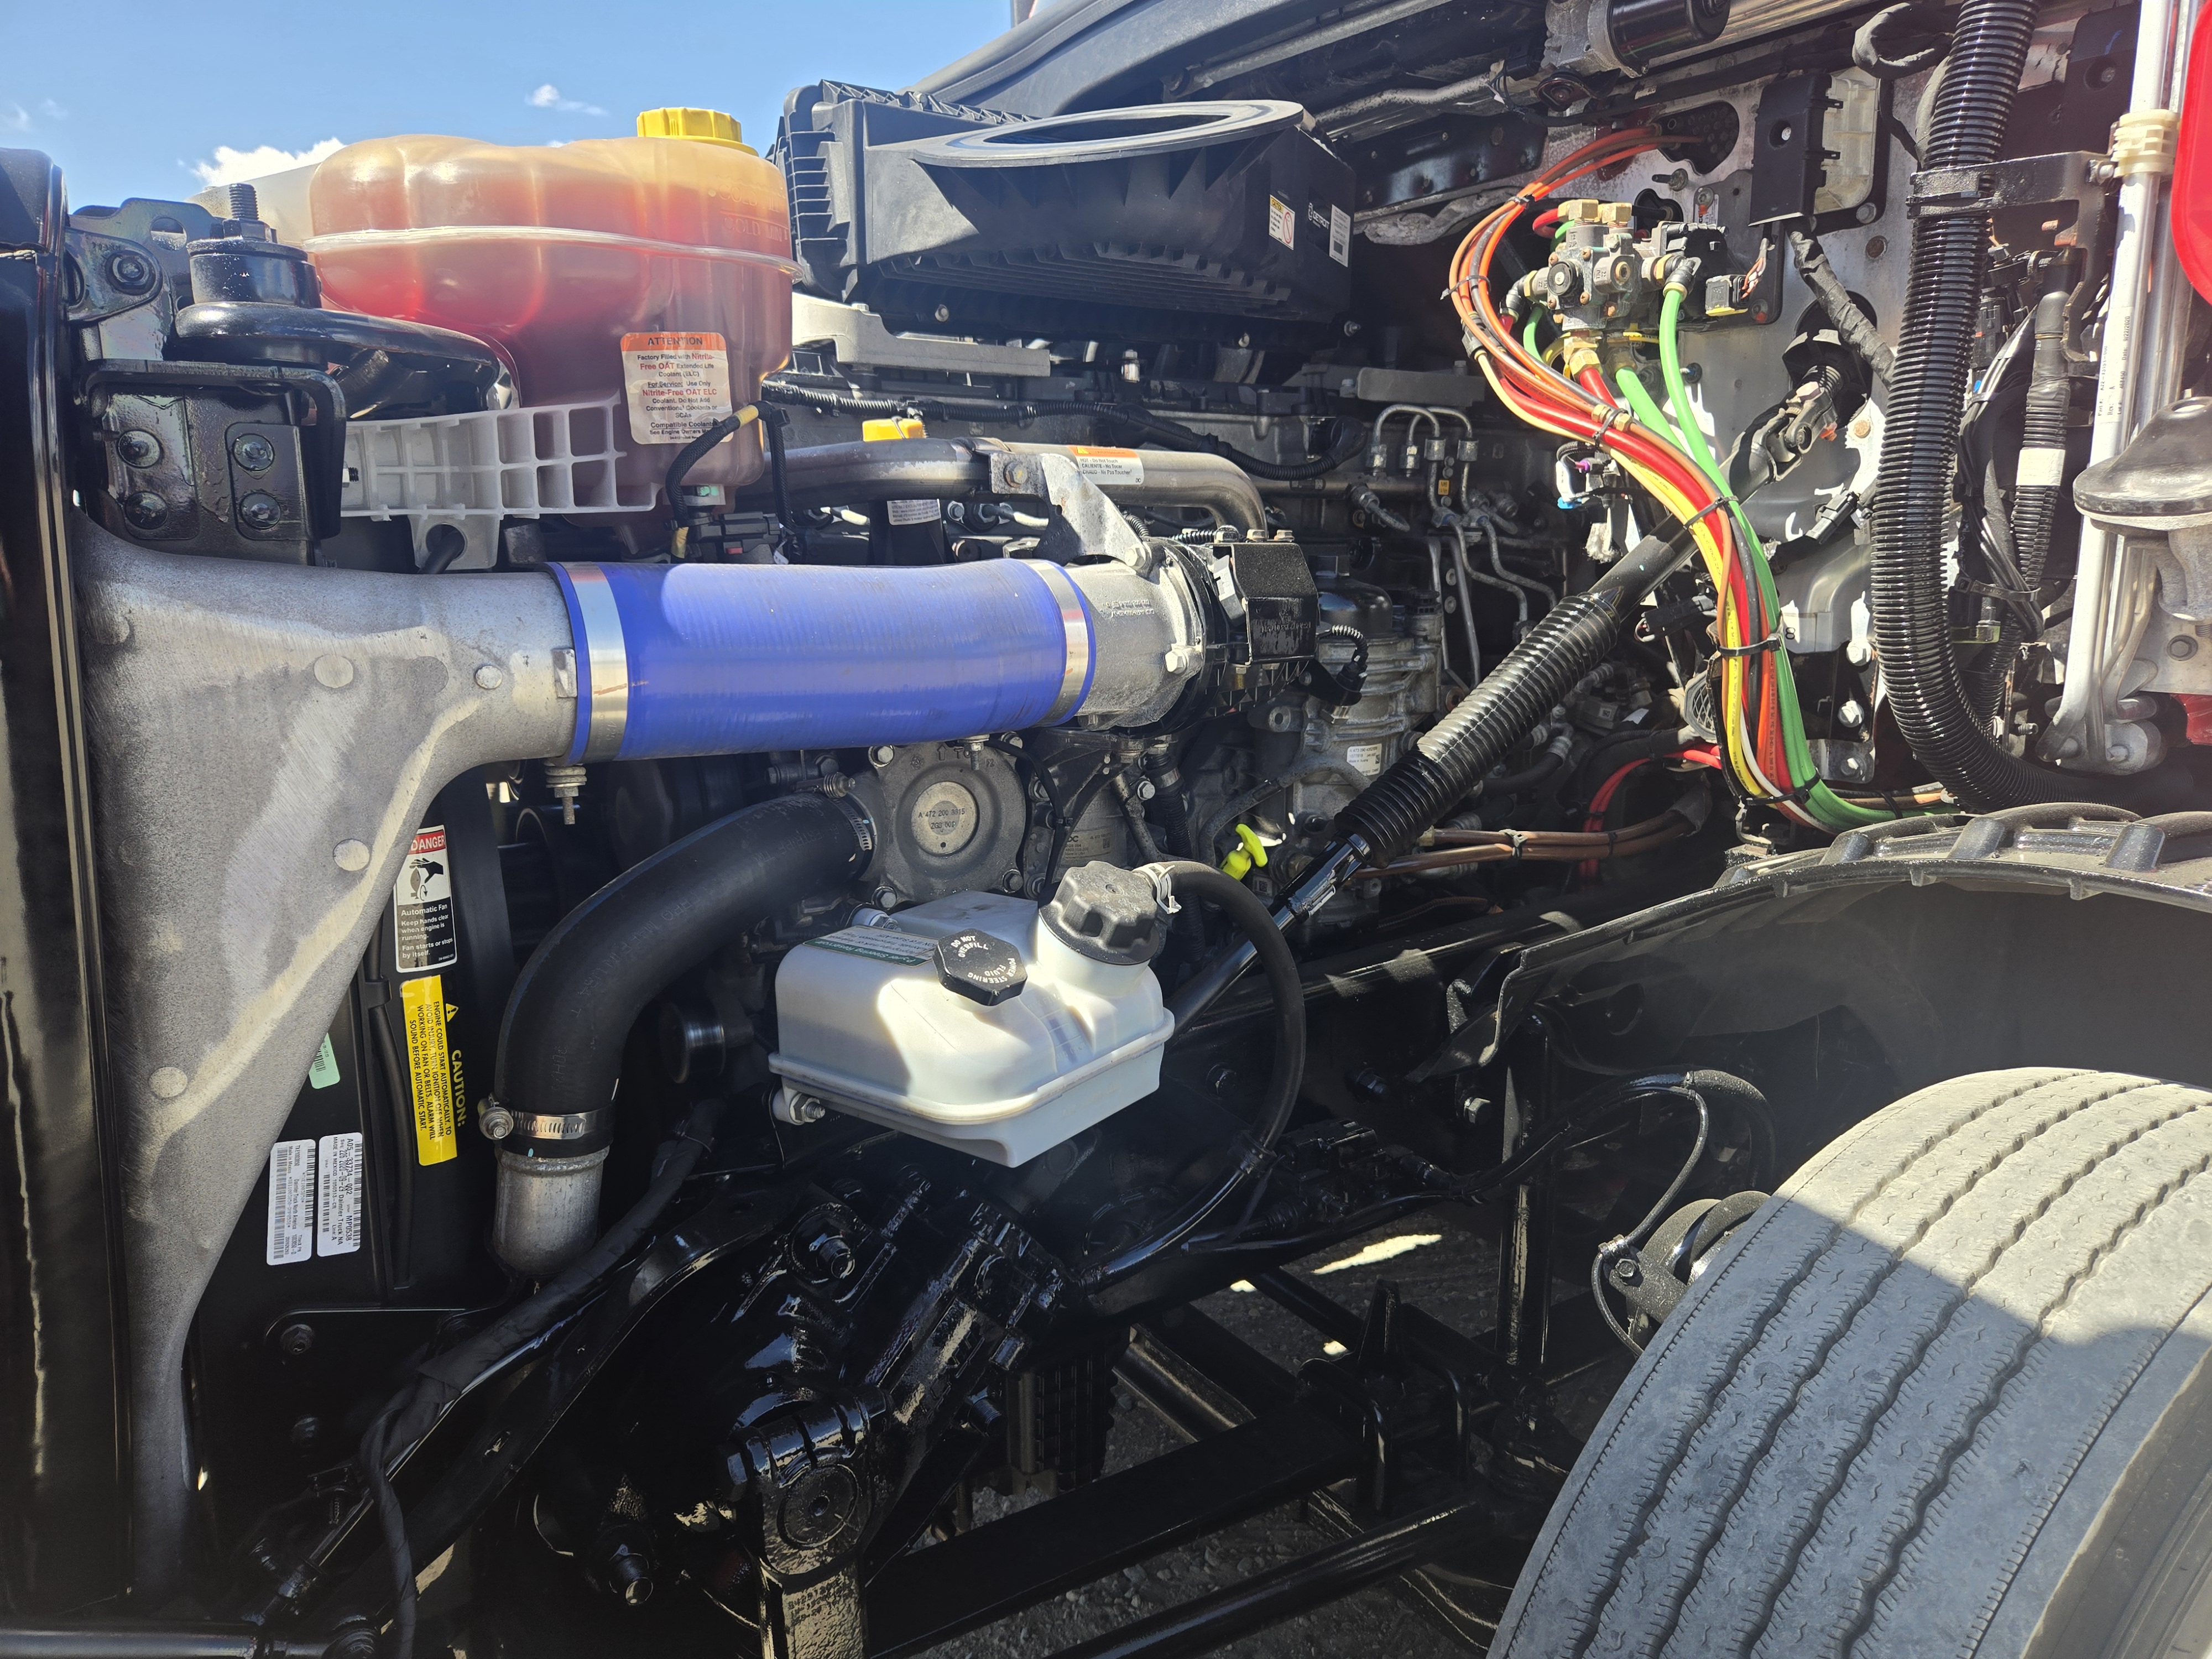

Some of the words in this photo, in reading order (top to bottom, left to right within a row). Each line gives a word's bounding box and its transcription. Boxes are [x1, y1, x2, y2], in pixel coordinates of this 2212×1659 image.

[1313, 211, 1330, 229] DETROIT
[648, 337, 703, 346] ATTENTION
[659, 361, 675, 369] OAT
[411, 834, 445, 852] DANGER
[401, 905, 437, 916] Automatic
[421, 924, 440, 933] engine
[442, 938, 453, 946] stops
[815, 940, 853, 951] Reservoir
[951, 939, 961, 948] DO
[855, 948, 888, 958] Steering
[958, 942, 989, 958] OVERFILL
[888, 954, 916, 963] Power
[984, 964, 1006, 977] FLUID
[967, 972, 1008, 984] STEERING
[433, 1001, 442, 1027] ENGINE
[418, 1005, 426, 1039] WORKING
[409, 1020, 418, 1044] SOUND
[421, 1040, 427, 1051] ON
[436, 1028, 444, 1051] COULD
[413, 1045, 421, 1071] BEFORE
[424, 1067, 430, 1078] OR
[415, 1072, 425, 1110] AUTOMATIC
[432, 1071, 441, 1102] IGNITION
[451, 1050, 466, 1127] CAUTION:
[419, 1110, 427, 1131] START.
[446, 1128, 452, 1136] TO
[337, 1235, 343, 1245] NA
